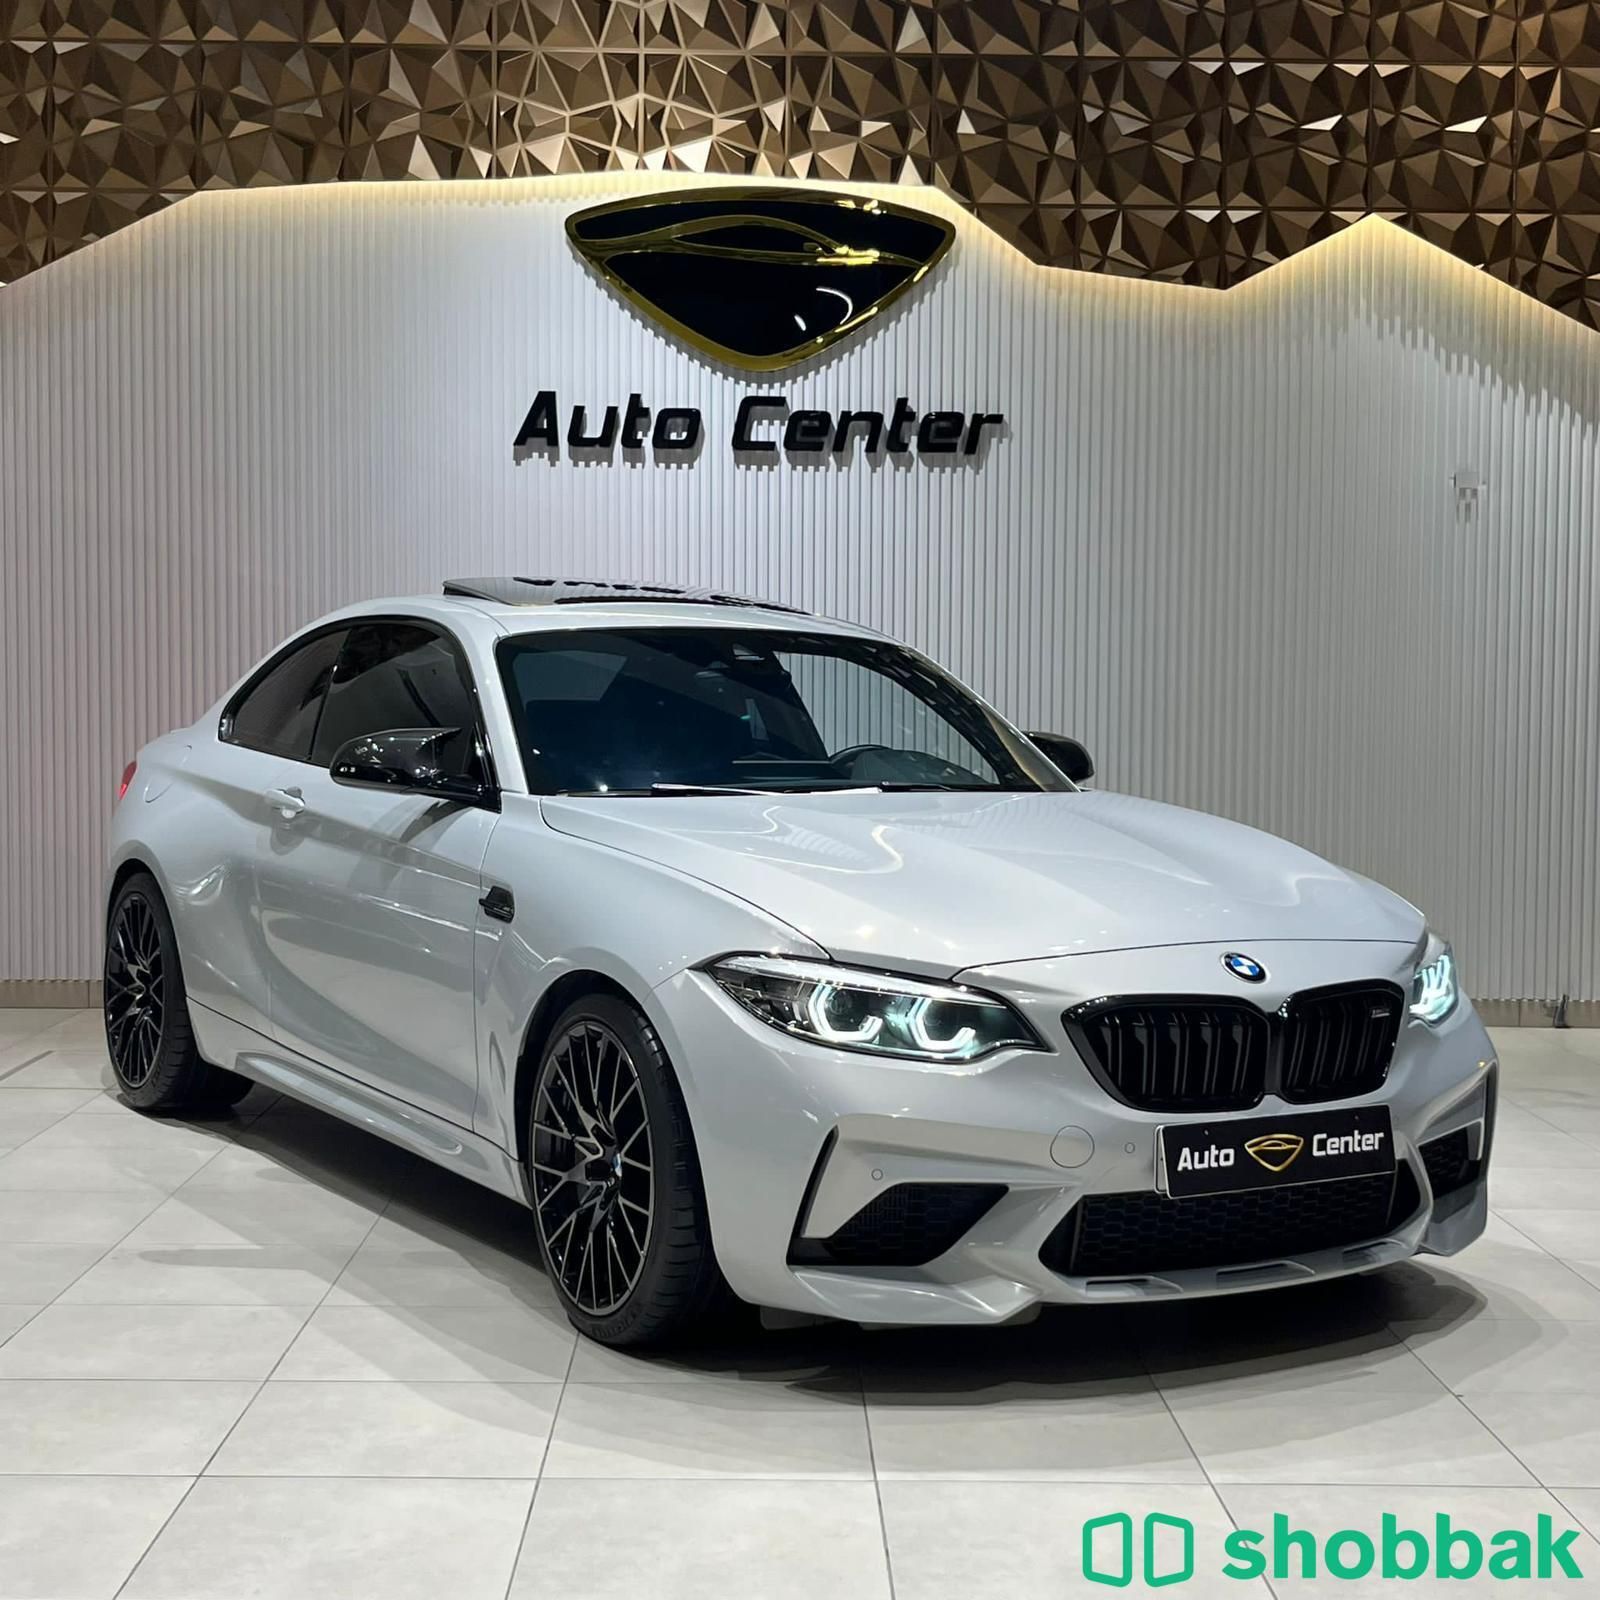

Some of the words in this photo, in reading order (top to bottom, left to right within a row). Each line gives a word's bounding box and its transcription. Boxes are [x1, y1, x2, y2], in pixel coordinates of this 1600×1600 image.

[513, 390, 701, 450] Auto
[732, 395, 1004, 456] Center
[1177, 1144, 1235, 1172] Auto
[1312, 1129, 1385, 1157] Center
